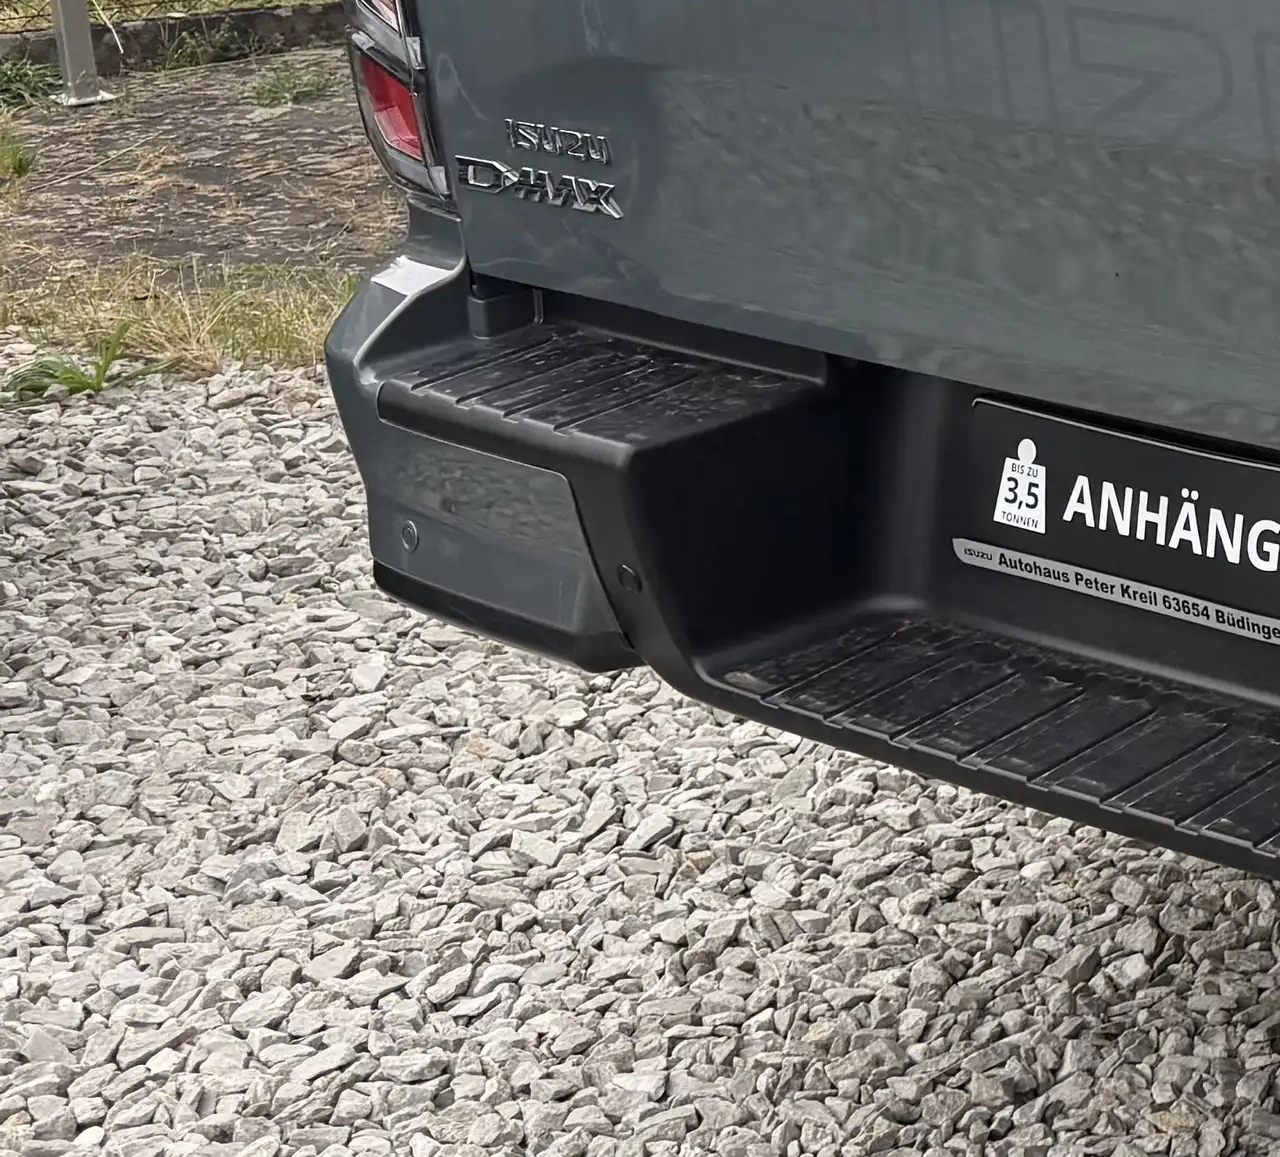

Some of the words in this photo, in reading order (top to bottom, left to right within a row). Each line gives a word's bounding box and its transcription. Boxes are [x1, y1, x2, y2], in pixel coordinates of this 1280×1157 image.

[505, 118, 612, 165] ISUZU
[1011, 463, 1025, 475] BIS
[1027, 466, 1039, 478] ZU
[1004, 476, 1040, 510] 3,5
[1001, 511, 1039, 529] TONNEN
[964, 548, 993, 561] ISUZU
[998, 552, 1070, 584] Autohaus
[1074, 572, 1116, 595] Peter
[1120, 583, 1158, 607] Kreil
[1162, 594, 1211, 621] 63654
